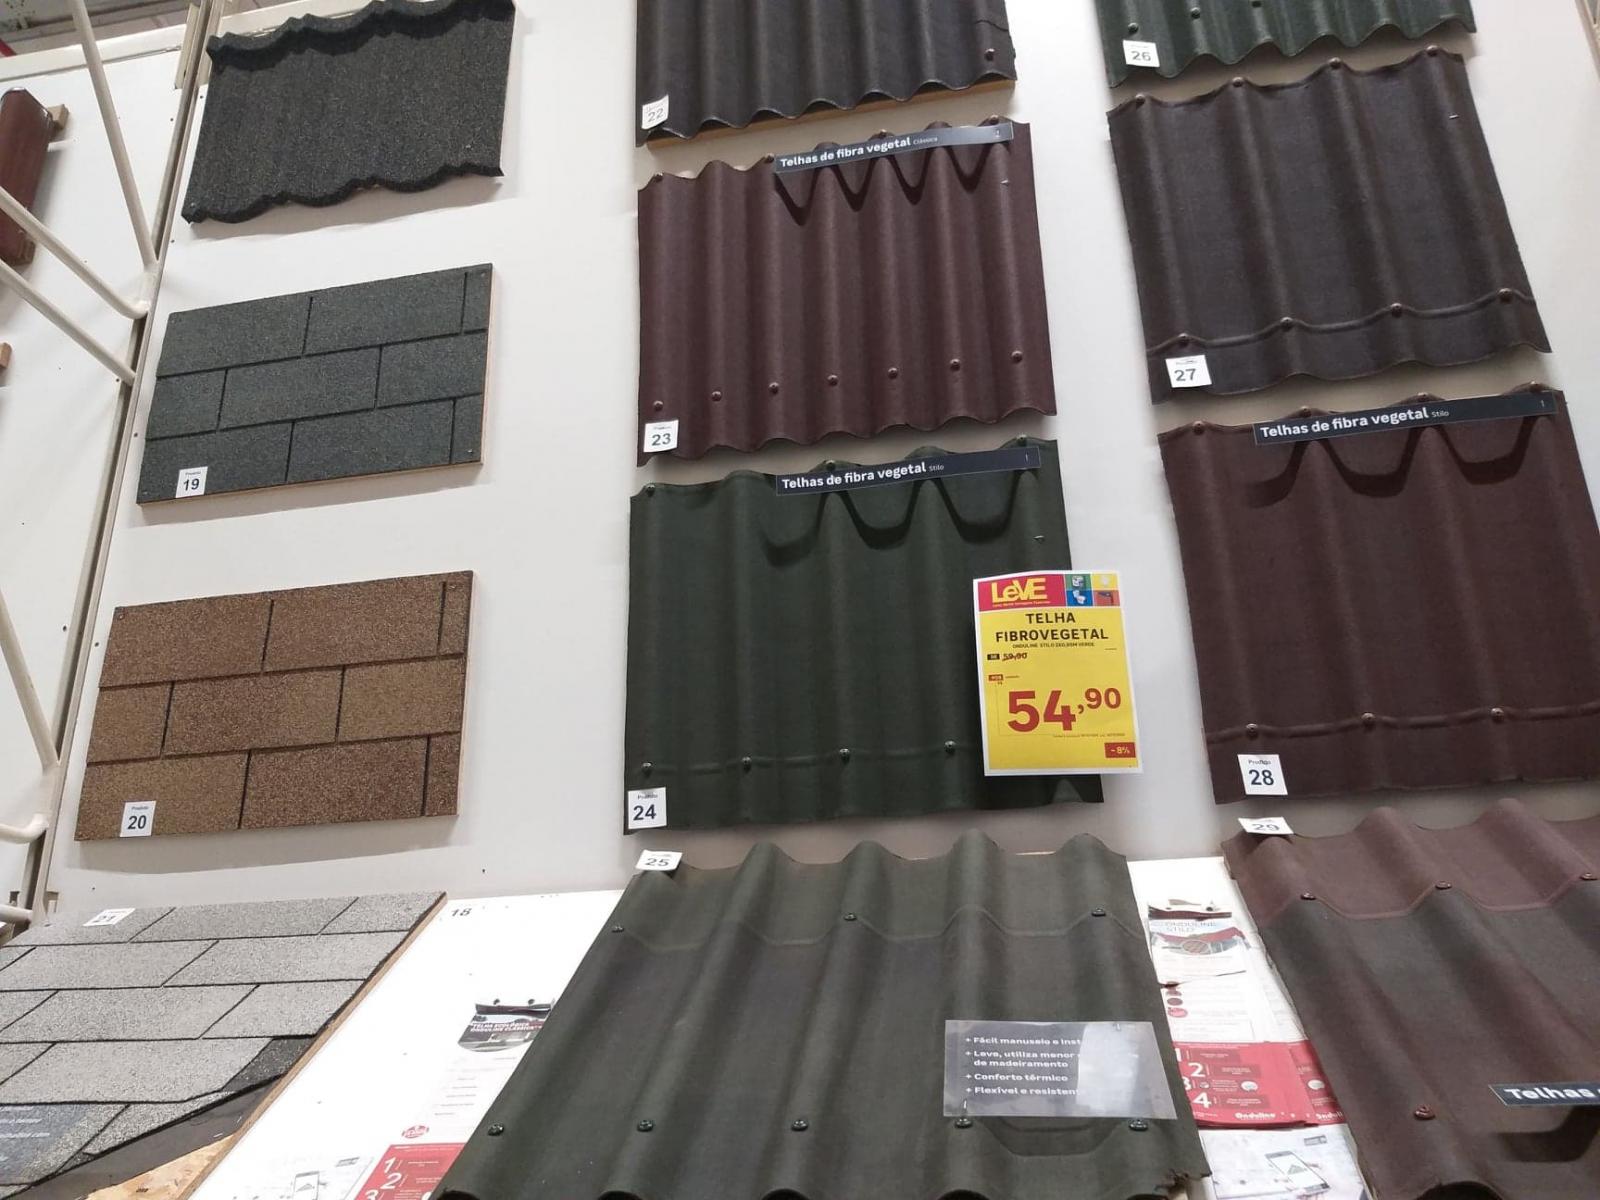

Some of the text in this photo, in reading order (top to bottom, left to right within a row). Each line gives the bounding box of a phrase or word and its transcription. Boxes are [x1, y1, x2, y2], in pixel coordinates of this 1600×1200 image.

[1131, 51, 1151, 61] 26
[648, 108, 664, 122] 22
[780, 154, 818, 168] Telhas
[820, 151, 835, 162] de
[836, 147, 864, 160] fibra
[866, 137, 911, 154] vegetal
[1174, 368, 1196, 382] 27
[1260, 406, 1450, 438] Telhas de fibra vegetal Stilo
[652, 433, 671, 446] 23
[782, 461, 945, 489] Telhas de fibra vegetal Stilo
[184, 478, 200, 491] 19
[1025, 612, 1076, 624] TELHA
[995, 628, 1109, 642] FIBROVEGETAL
[1008, 687, 1122, 733] 54,90
[1249, 769, 1275, 786] 28
[633, 804, 656, 821] 24
[128, 815, 147, 830] 20
[1252, 823, 1280, 831] 29
[645, 857, 670, 867] 25
[973, 1036, 998, 1045] Fácil
[1000, 1038, 1051, 1046] manuseio
[974, 1050, 1002, 1059] Leve,
[1004, 1050, 1039, 1058] utiliza
[989, 1060, 1069, 1068] madeiramento
[1188, 1062, 1206, 1078] 2
[974, 1073, 1069, 1082] Conforto térmico
[974, 1086, 1018, 1095] Flexível
[1503, 1087, 1596, 1100] Telhas
[1193, 1091, 1212, 1109] 4
[384, 1157, 396, 1173] 1
[380, 1173, 402, 1189] 2
